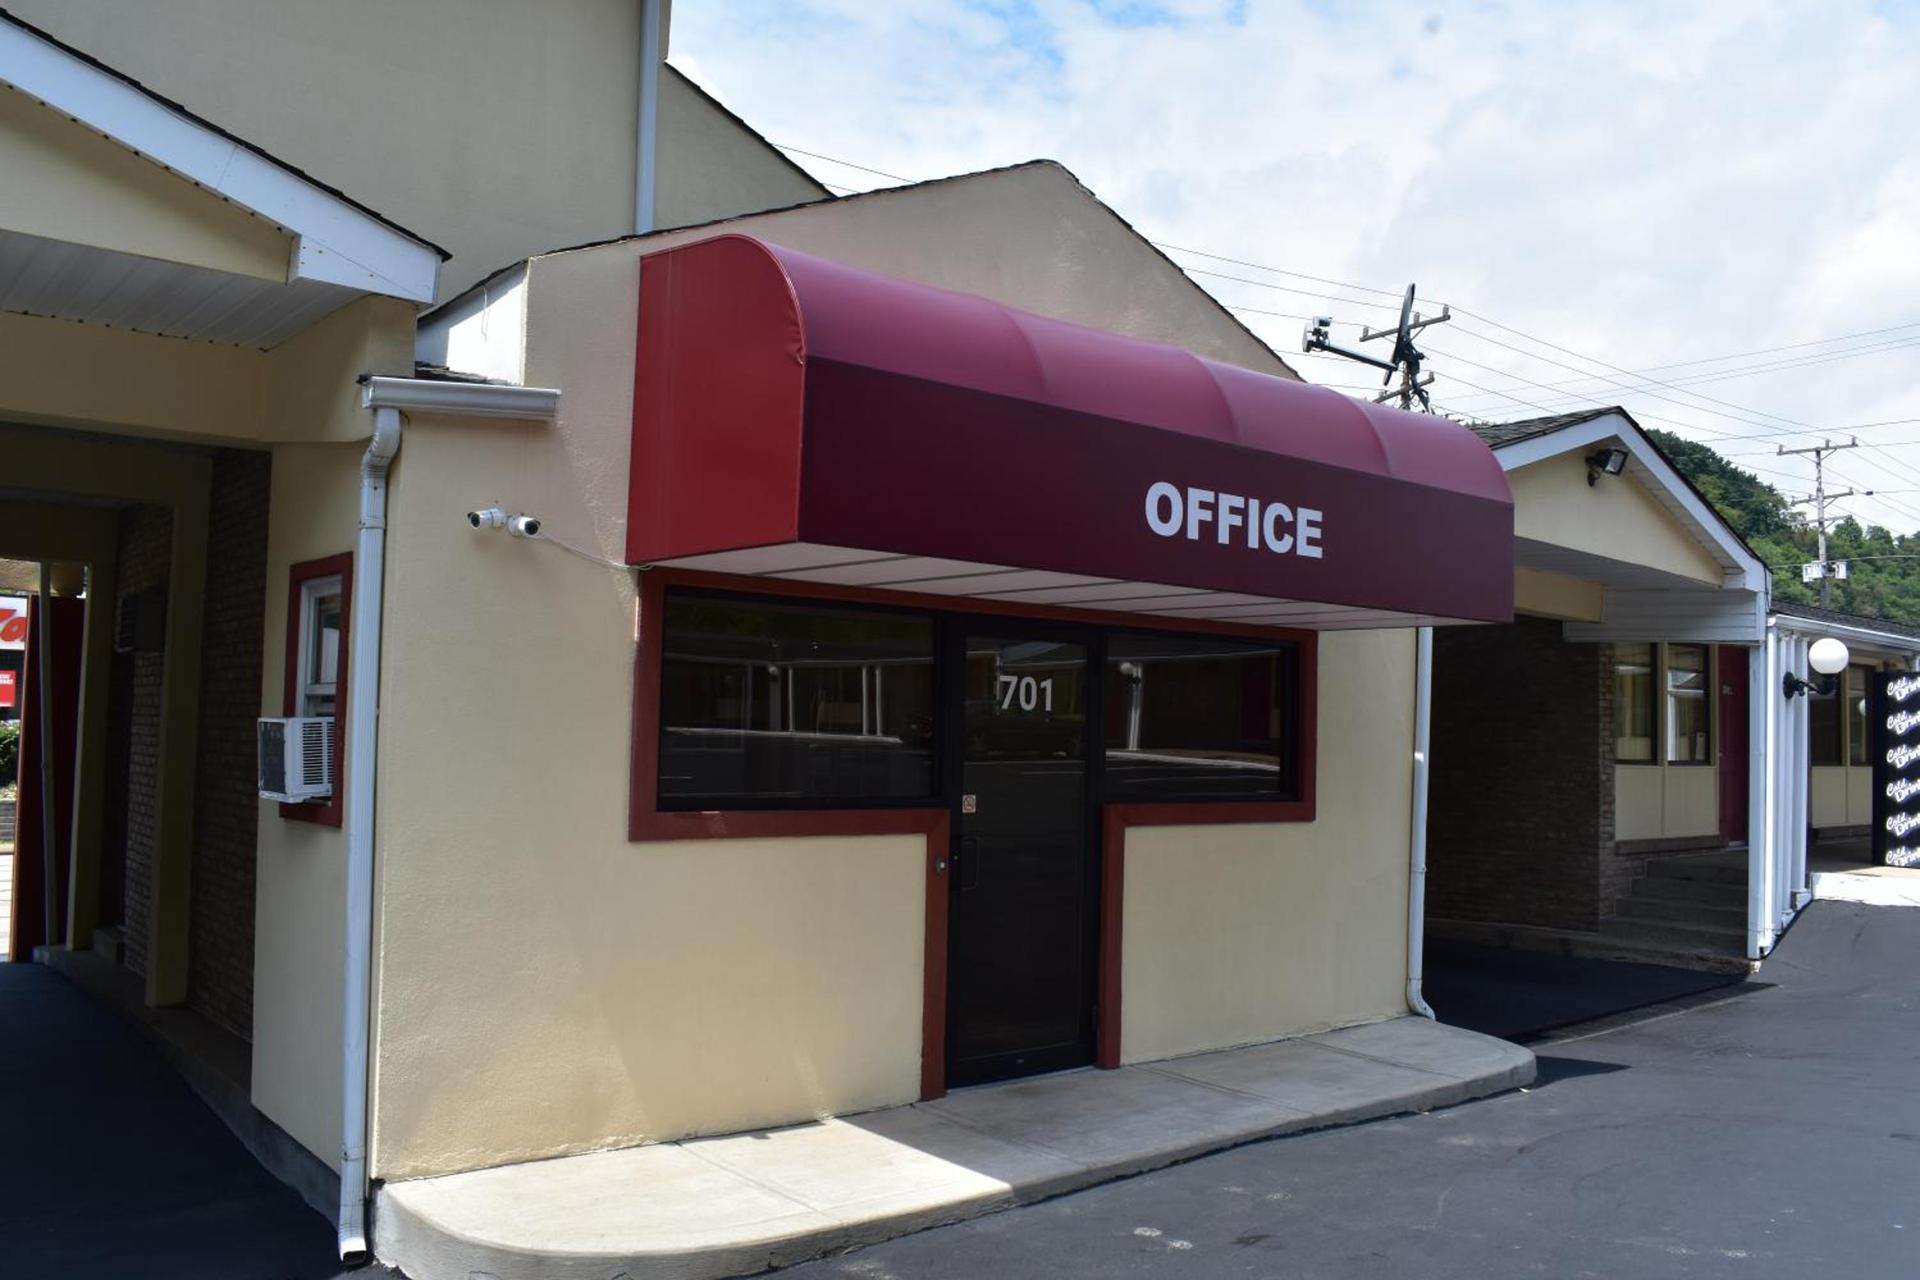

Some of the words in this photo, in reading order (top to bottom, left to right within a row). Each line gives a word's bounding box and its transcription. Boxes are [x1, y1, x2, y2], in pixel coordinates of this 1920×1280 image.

[1145, 482, 1323, 559] OFFICE
[1000, 675, 1052, 711] 701
[1887, 676, 1907, 696] Cold
[1887, 710, 1907, 730] Cold
[1886, 744, 1907, 763] Cold
[1886, 778, 1907, 797] Cold
[1886, 812, 1907, 831] Cold
[1885, 846, 1907, 864] Cold
